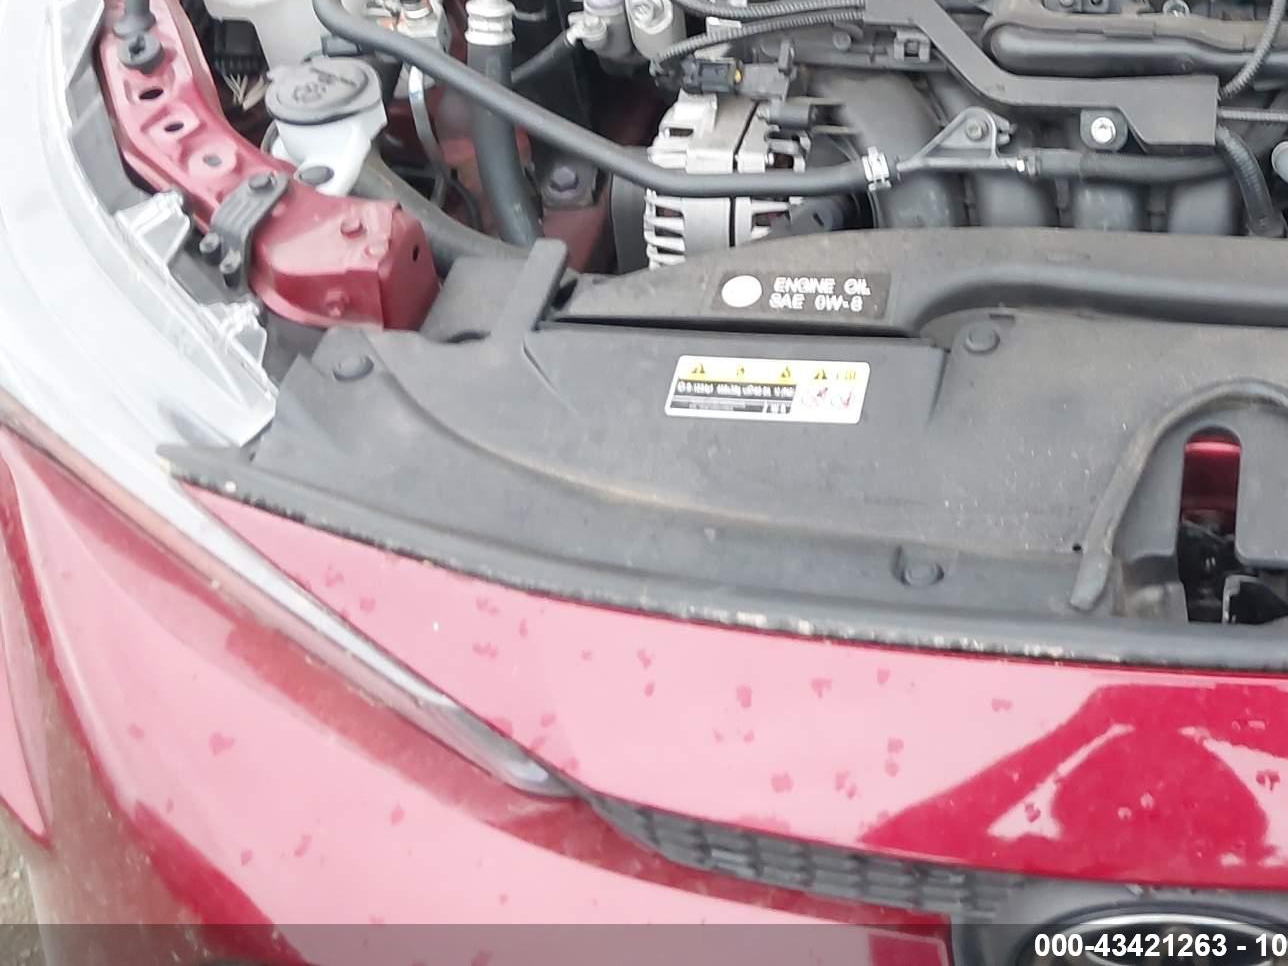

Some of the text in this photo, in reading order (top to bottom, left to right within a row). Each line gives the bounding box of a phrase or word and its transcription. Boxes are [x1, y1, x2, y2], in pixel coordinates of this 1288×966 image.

[774, 277, 871, 295] ENGINE OIL
[769, 293, 863, 312] SAE 0W-8
